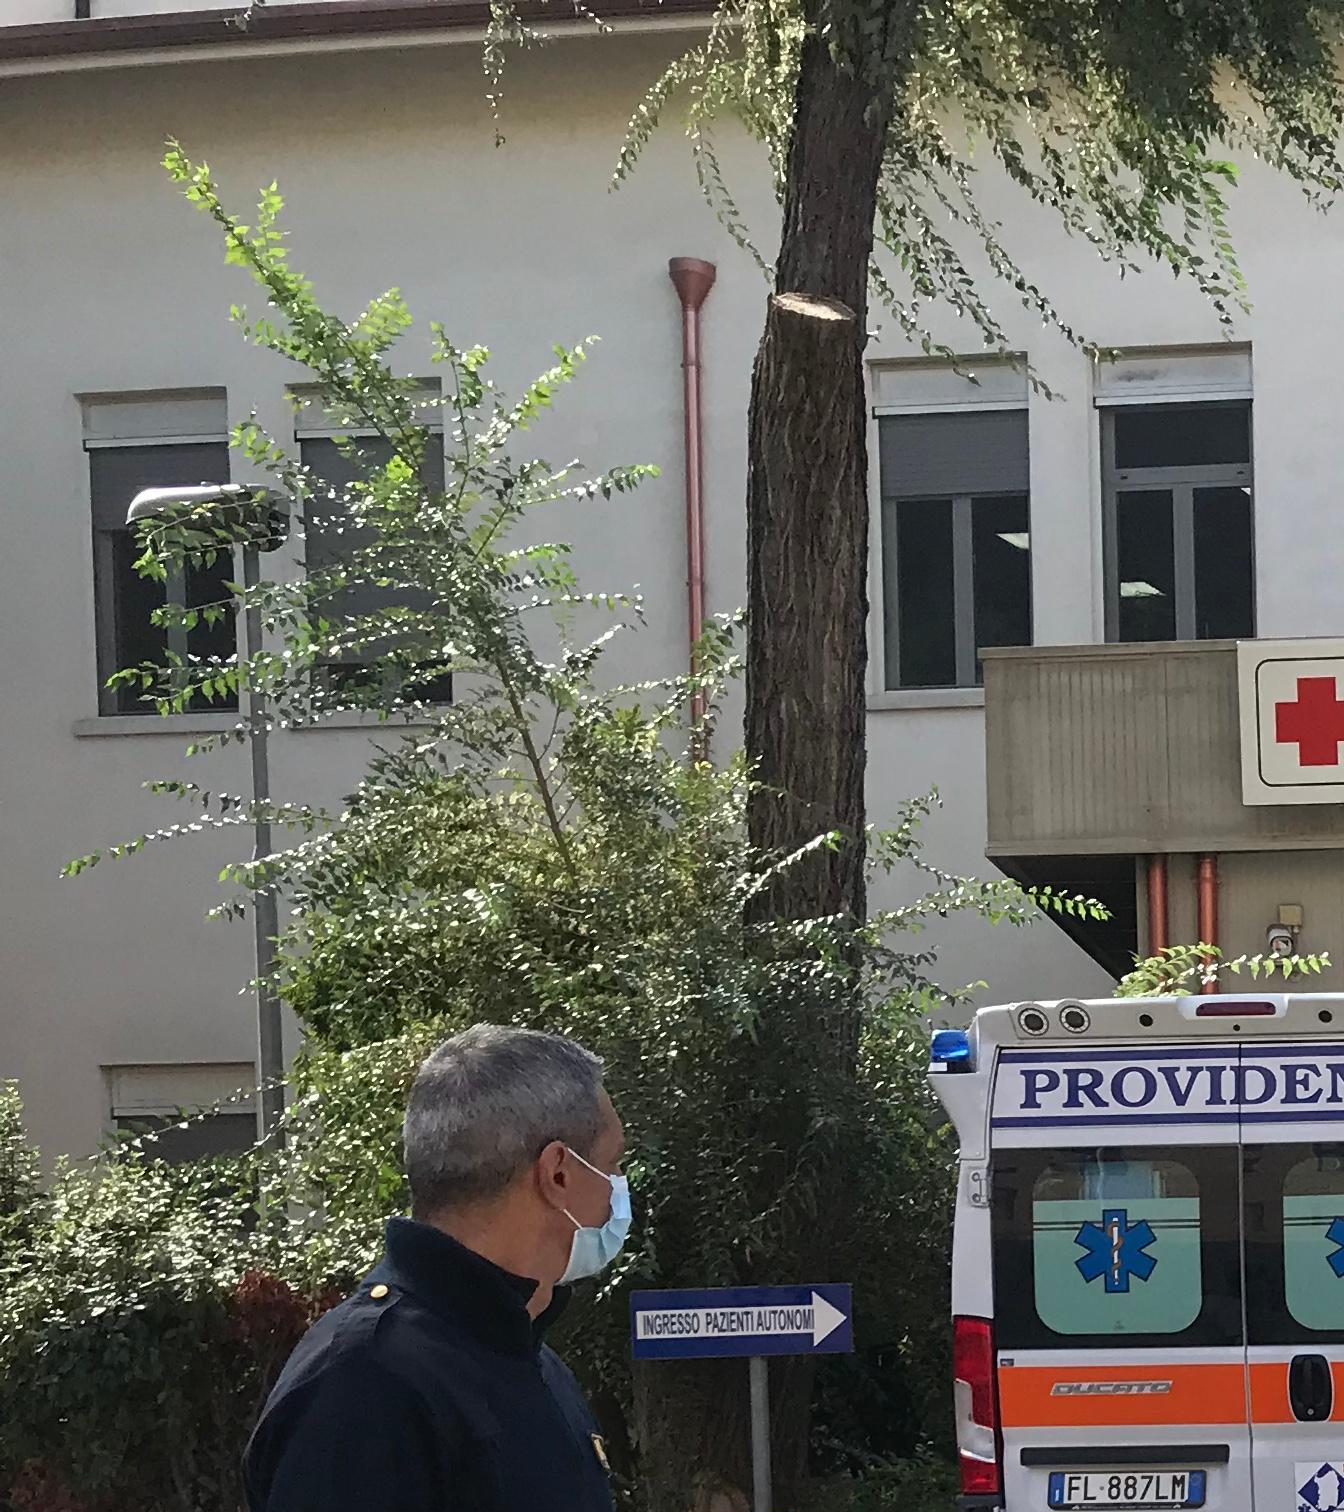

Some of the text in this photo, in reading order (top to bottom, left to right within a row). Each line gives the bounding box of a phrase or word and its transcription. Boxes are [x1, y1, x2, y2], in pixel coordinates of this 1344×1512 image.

[642, 1308, 815, 1336] INGRESSO PAZIENTI AUTONOMI
[1054, 1381, 1171, 1396] DUCATO
[1067, 1475, 1097, 1501] FL
[1107, 1474, 1186, 1501] 887LM
